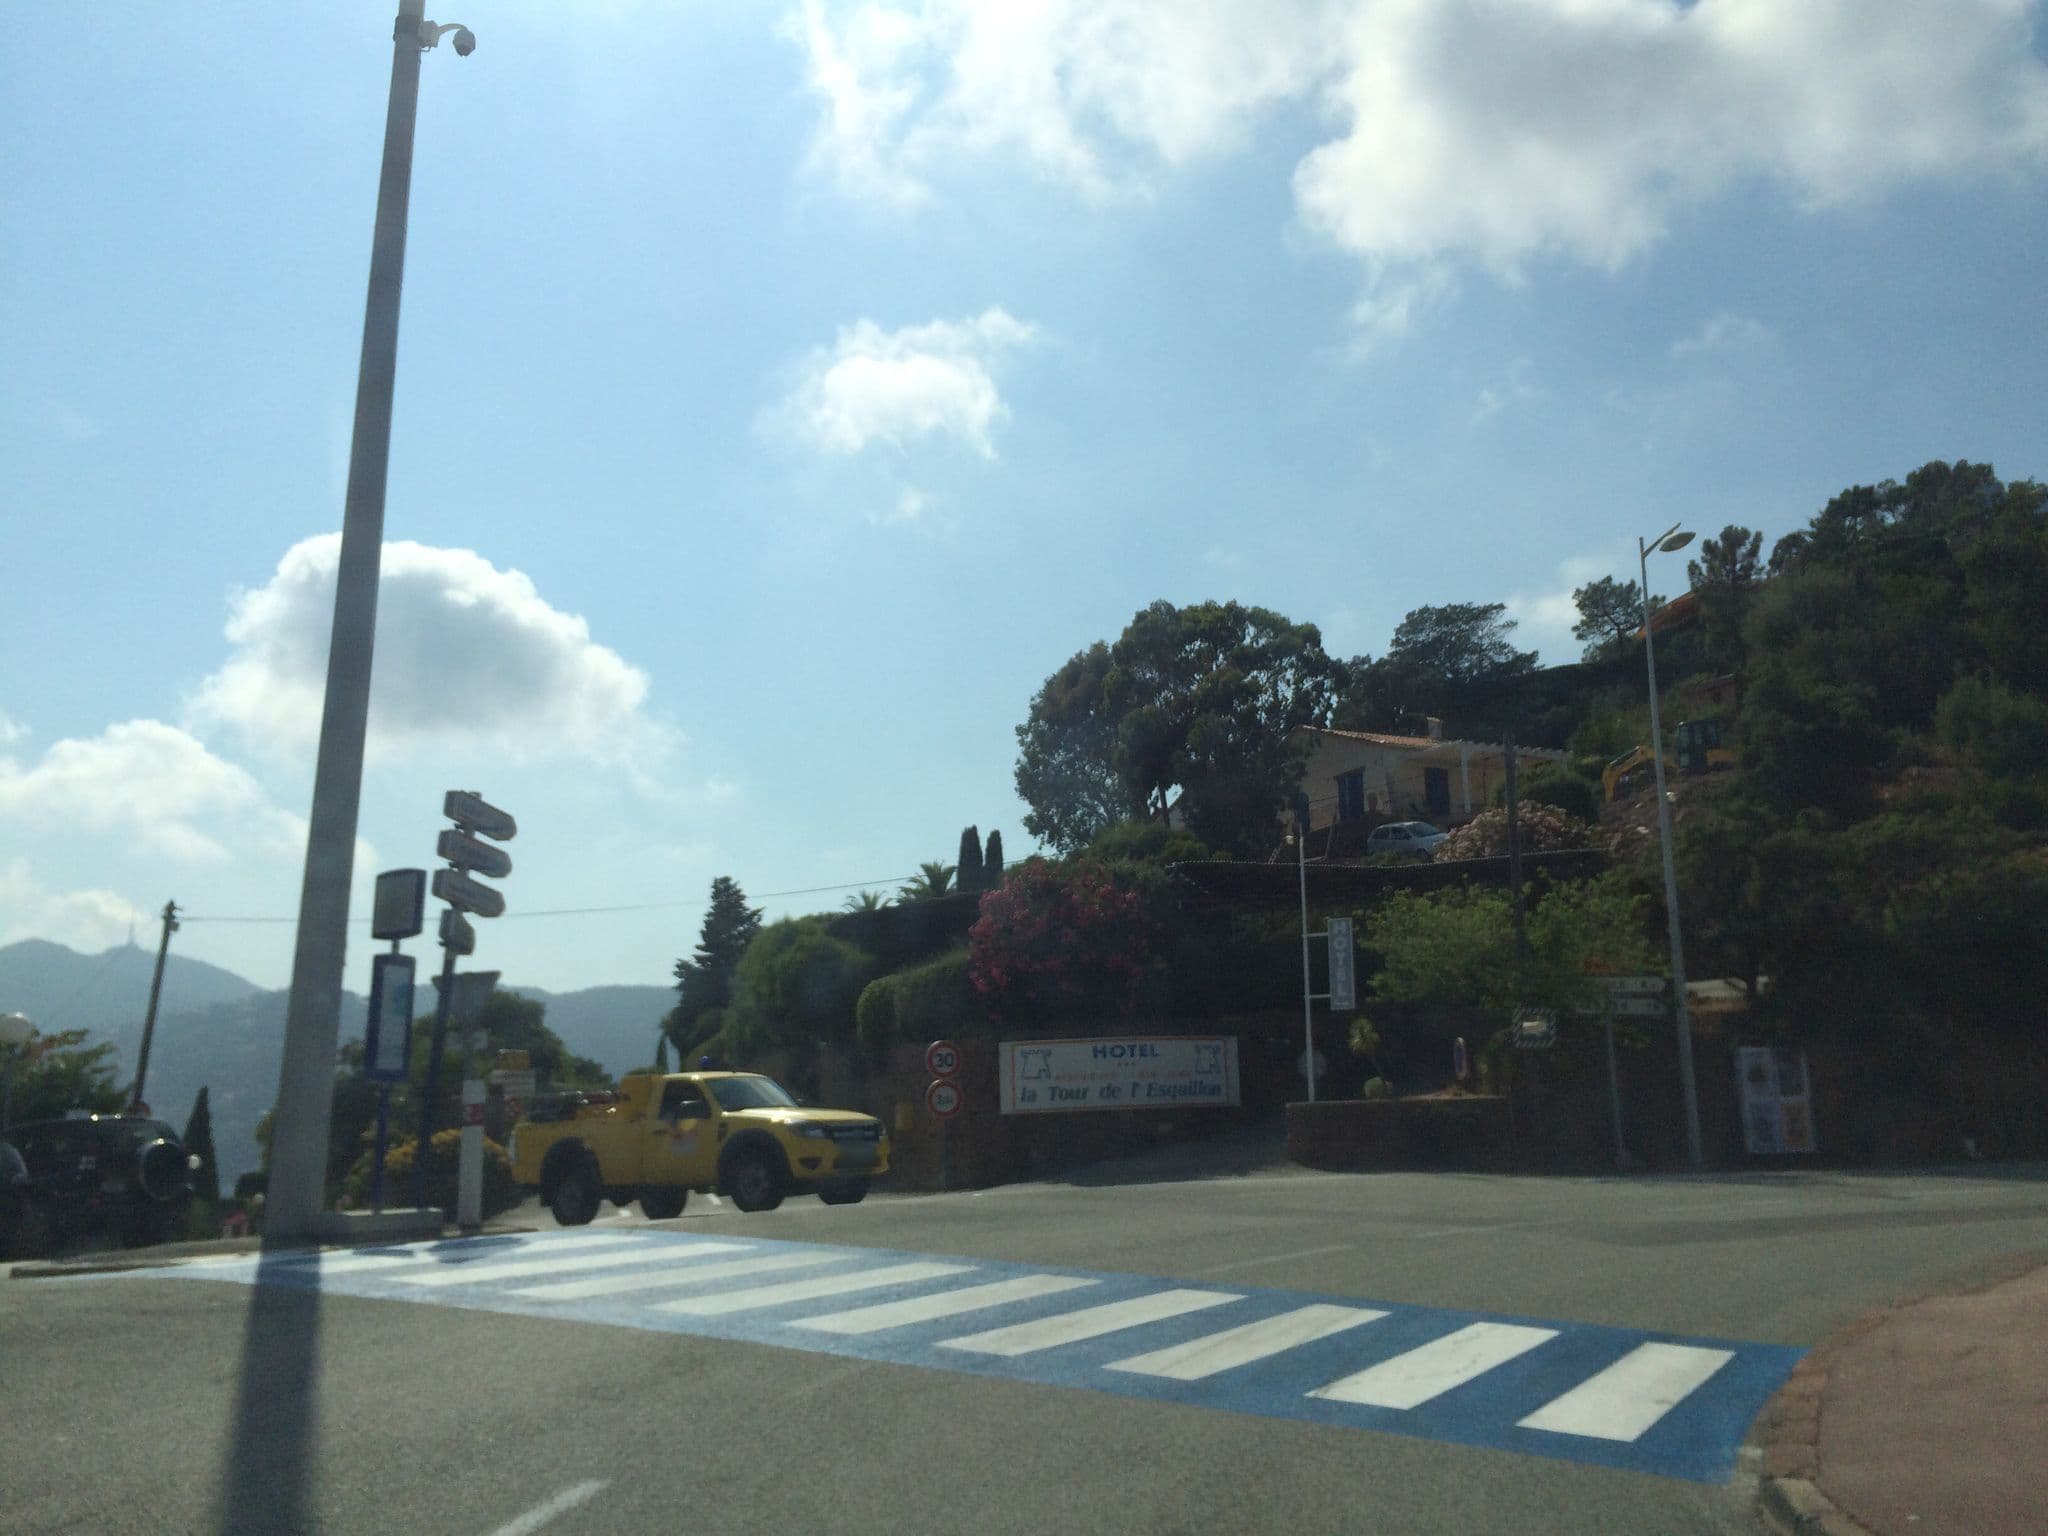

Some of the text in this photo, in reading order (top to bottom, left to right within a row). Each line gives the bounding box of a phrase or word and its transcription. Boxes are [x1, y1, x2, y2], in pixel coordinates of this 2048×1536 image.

[1333, 920, 1347, 995] HOTEL
[1092, 1043, 1160, 1058] HOTEL
[1021, 1087, 1037, 1102] la
[1048, 1086, 1088, 1101] Tour
[1099, 1083, 1121, 1098] de
